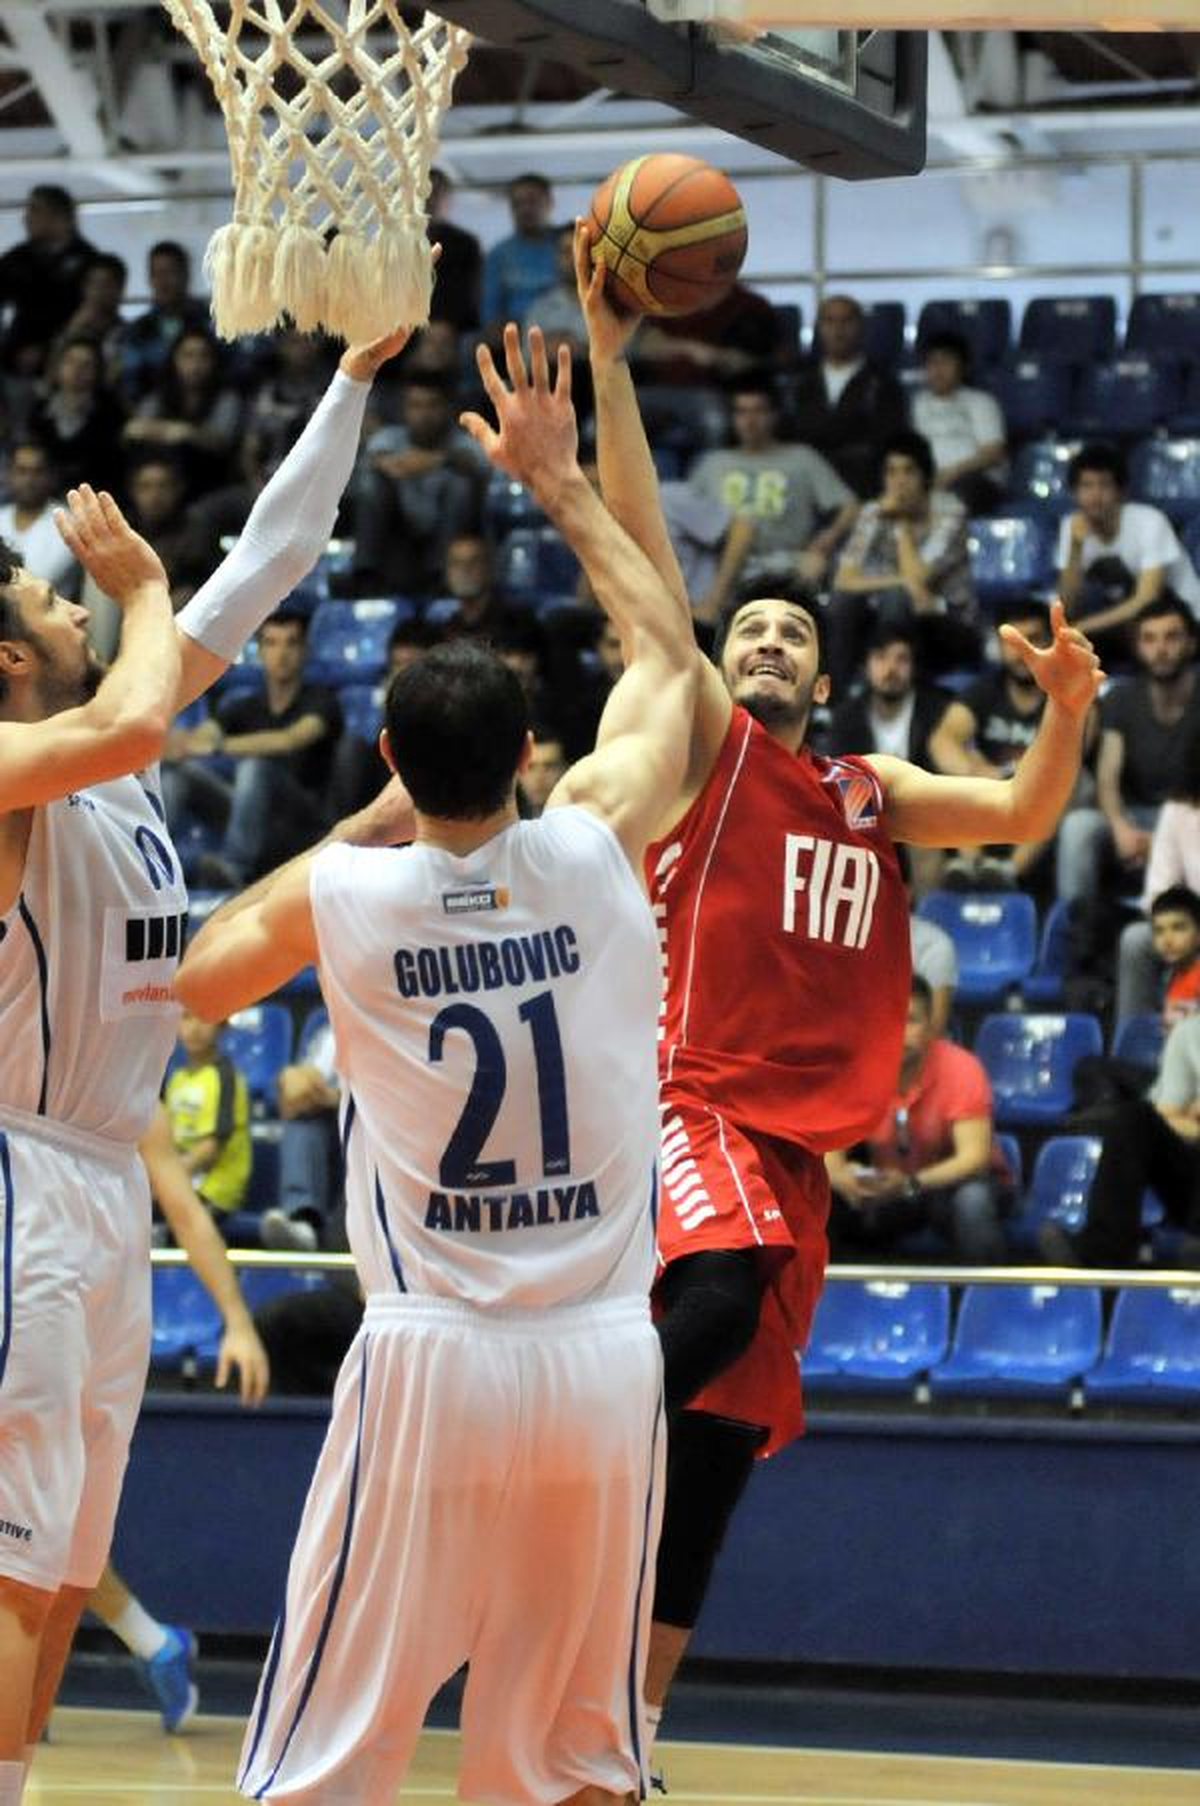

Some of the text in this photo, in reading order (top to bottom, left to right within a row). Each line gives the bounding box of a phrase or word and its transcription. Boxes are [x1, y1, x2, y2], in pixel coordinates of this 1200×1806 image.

[394, 925, 580, 998] GOLUBOVIC
[428, 990, 570, 1189] 21
[424, 1181, 600, 1232] ANTALYA
